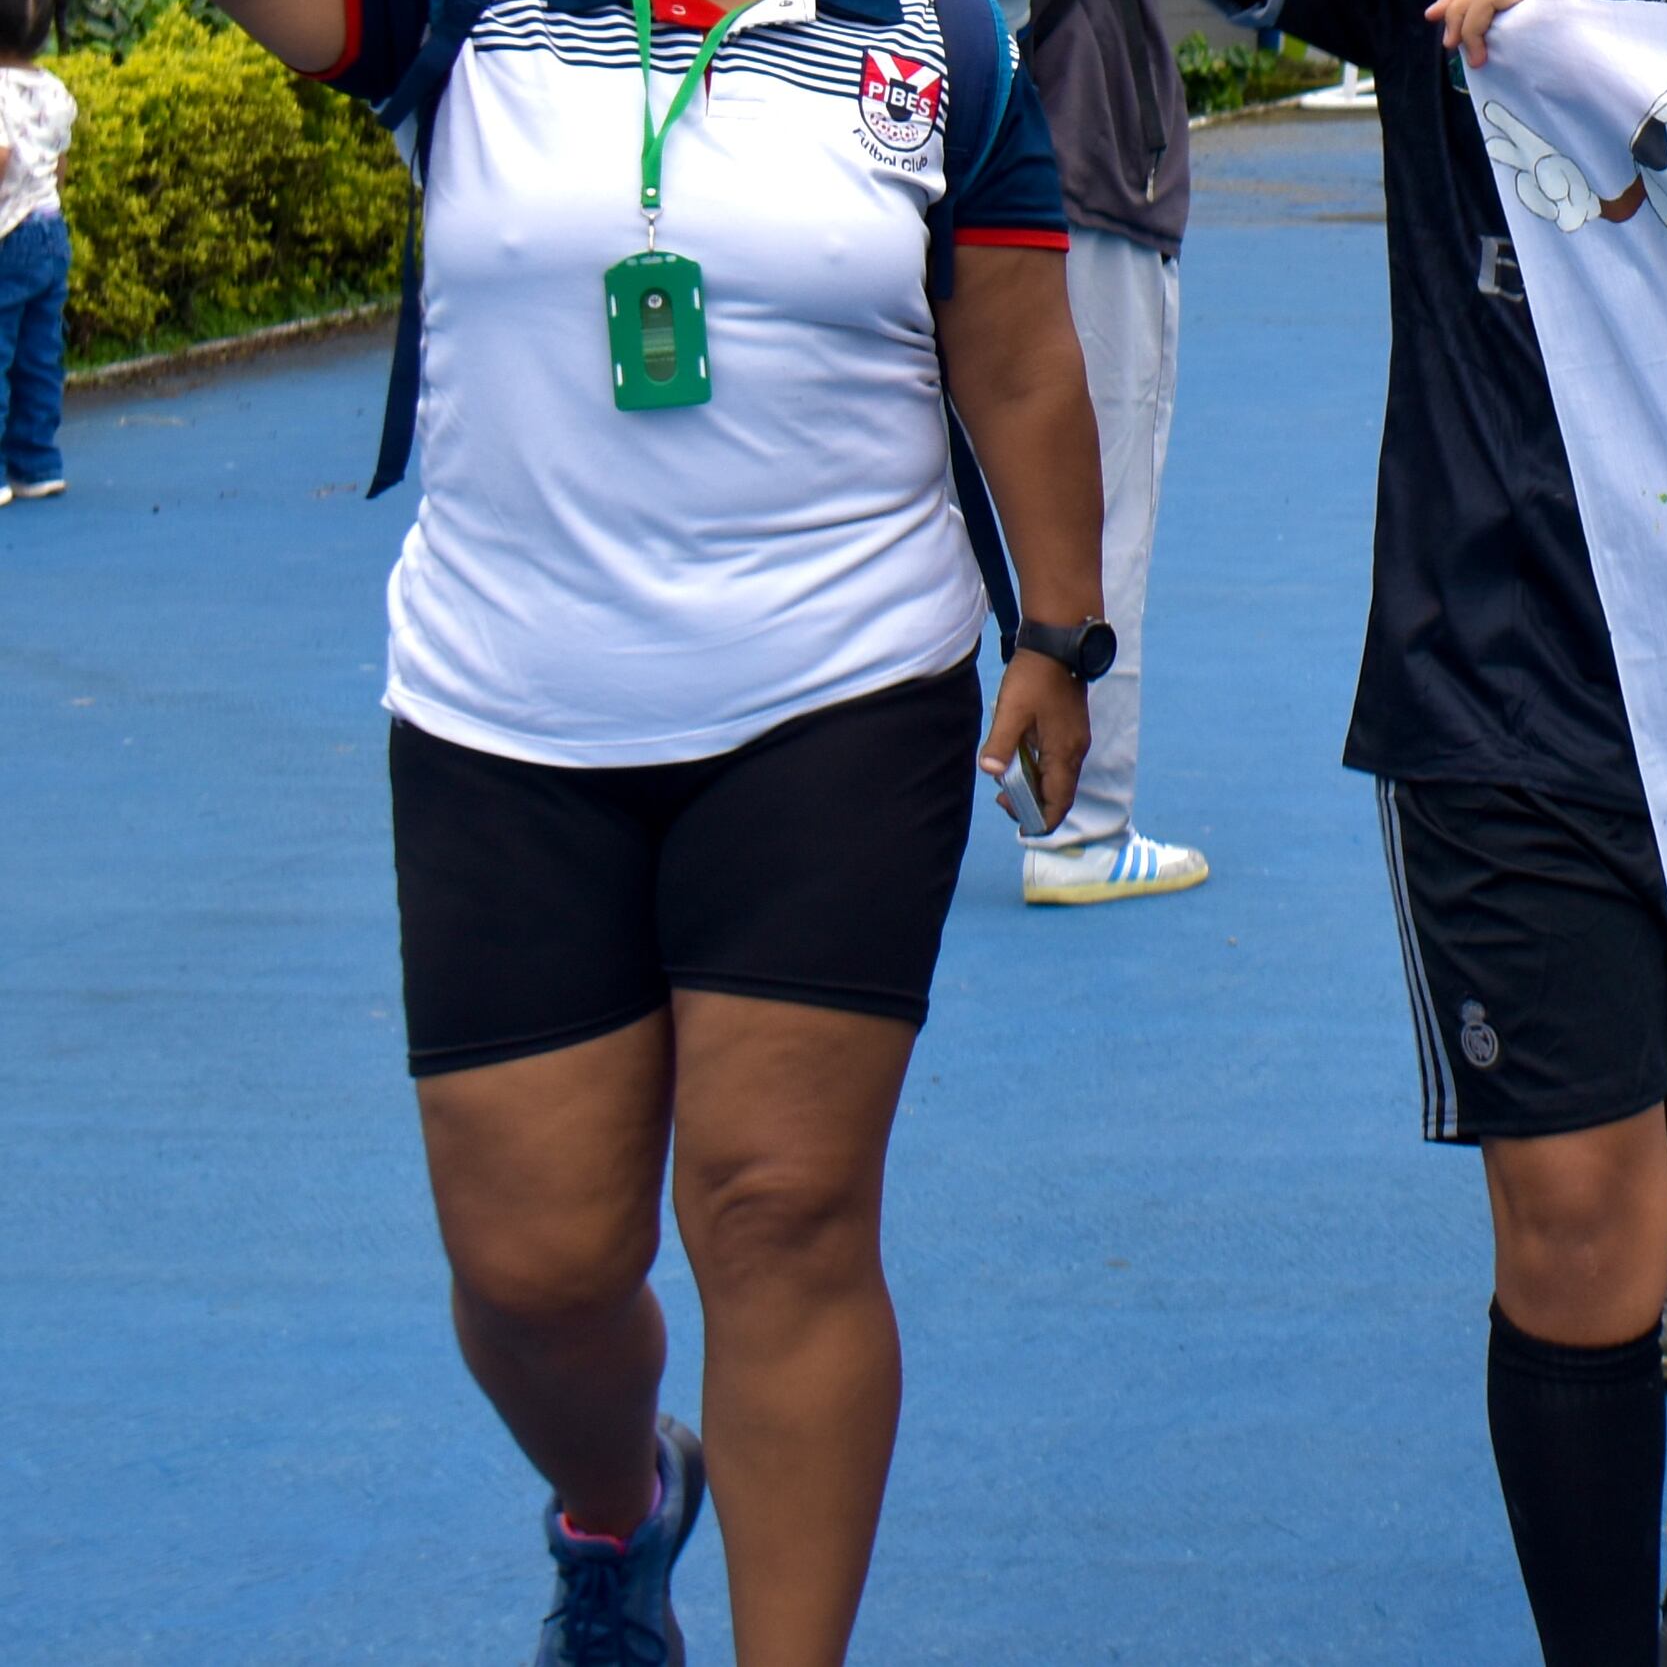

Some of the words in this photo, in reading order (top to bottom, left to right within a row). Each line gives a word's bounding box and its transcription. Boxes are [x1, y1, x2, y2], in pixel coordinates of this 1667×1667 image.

[868, 80, 932, 117] PIBES
[852, 127, 898, 167] Futbol
[901, 153, 929, 174] Club
